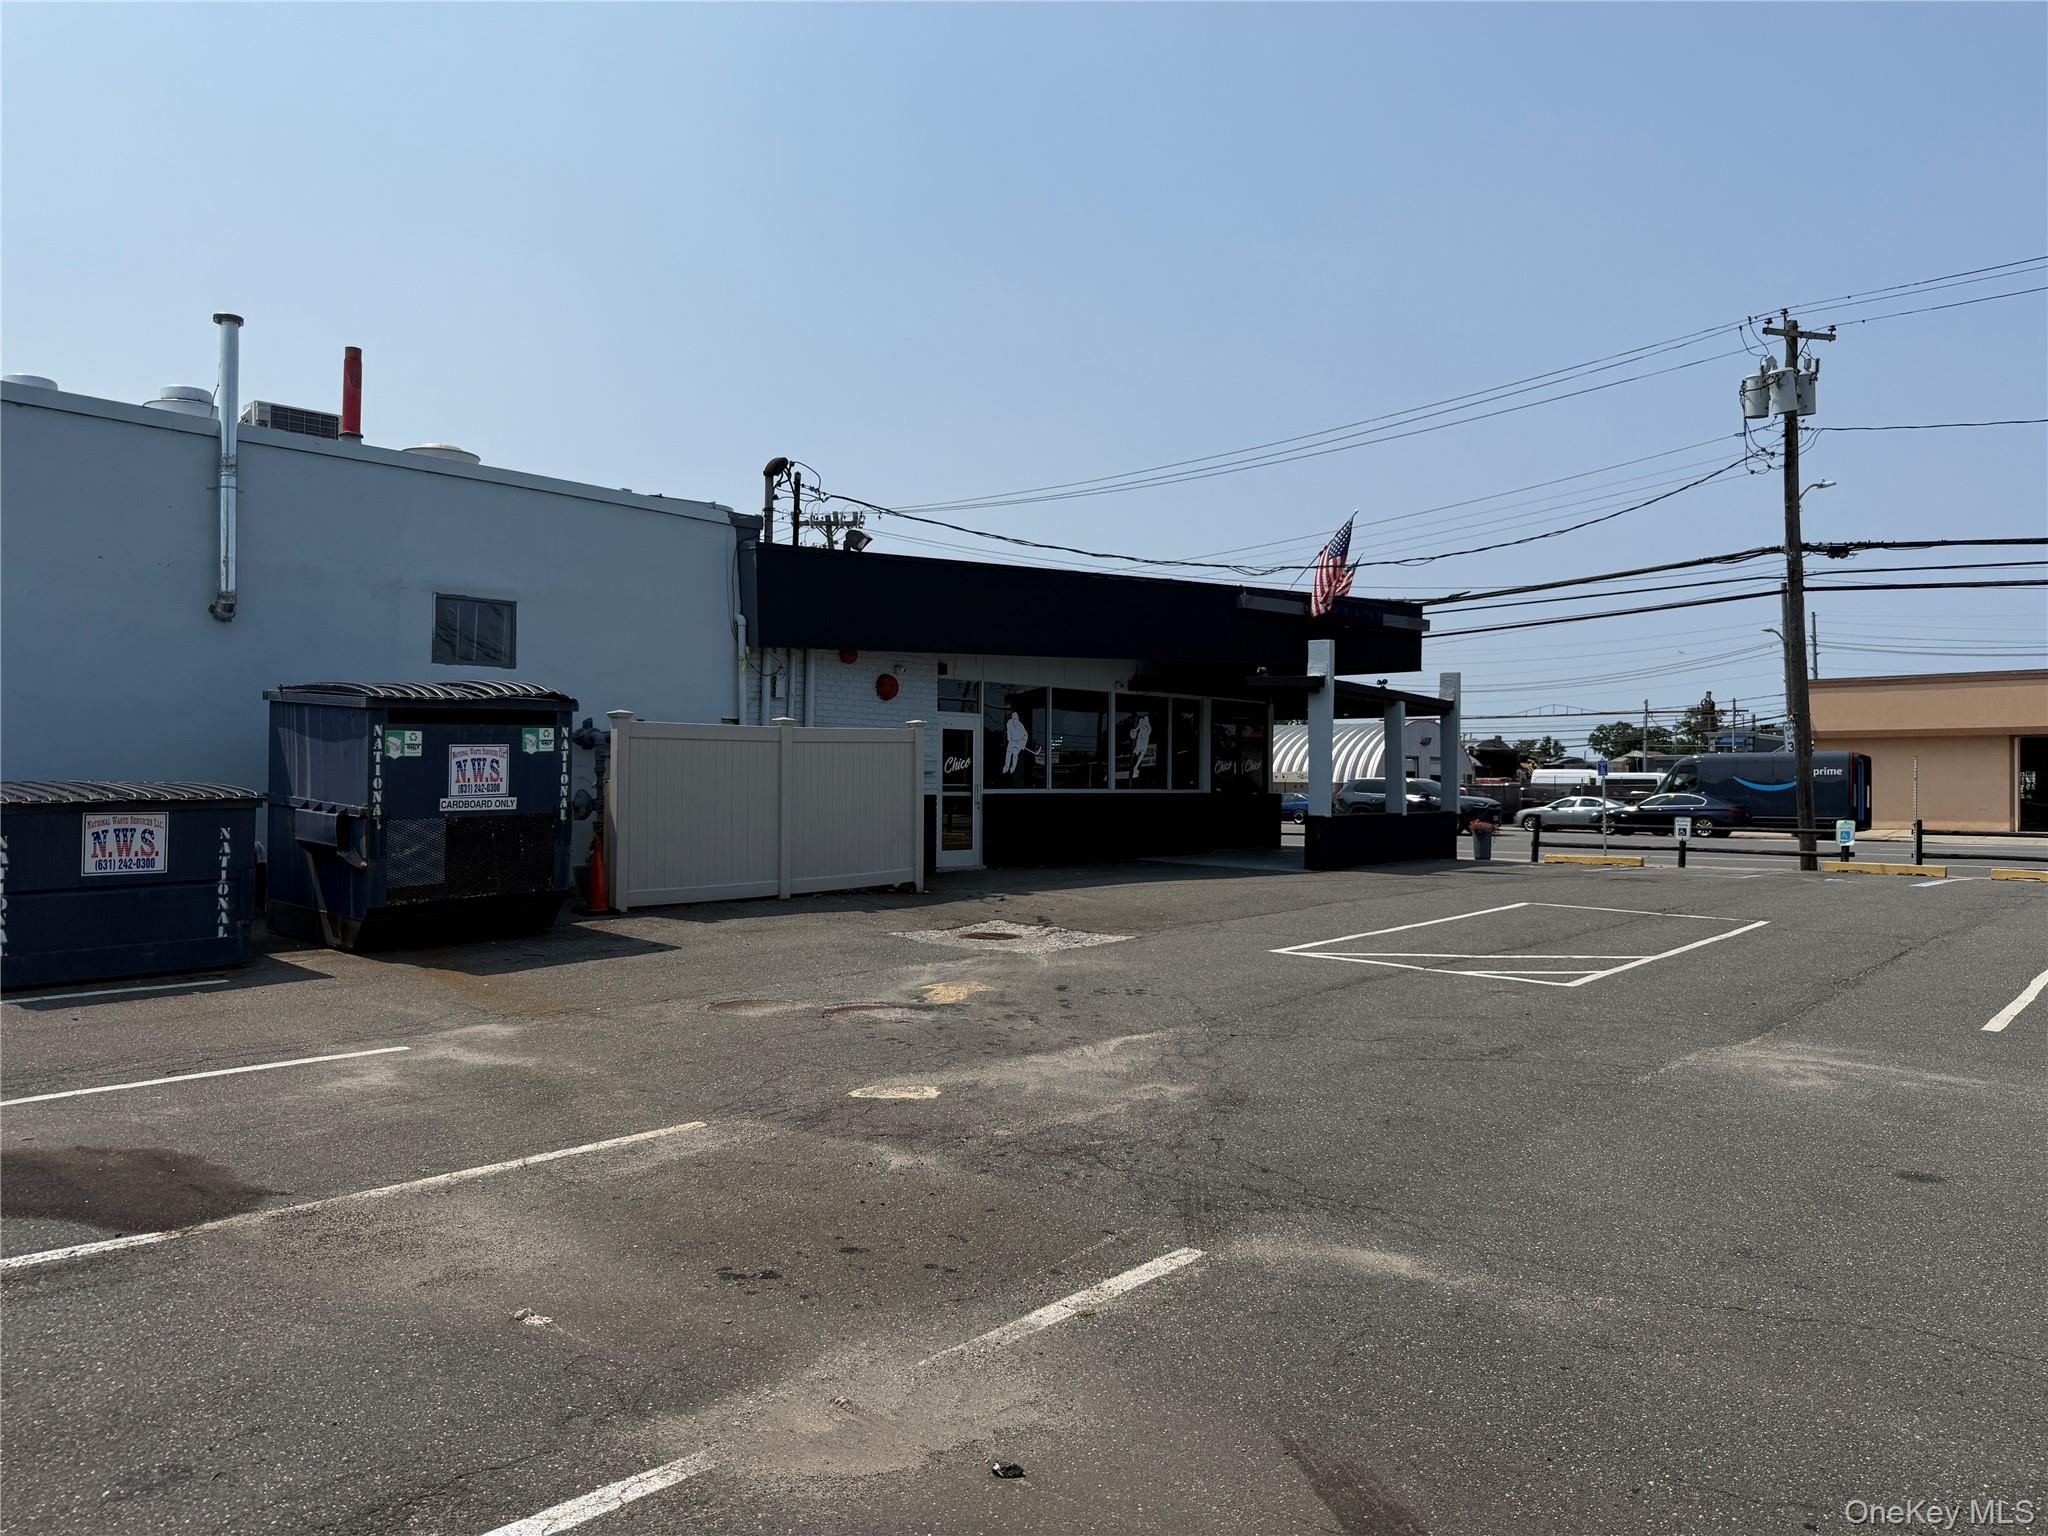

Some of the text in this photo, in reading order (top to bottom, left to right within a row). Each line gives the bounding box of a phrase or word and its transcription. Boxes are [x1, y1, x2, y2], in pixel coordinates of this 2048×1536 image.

[372, 724, 383, 830] NATIONAL
[455, 758, 503, 783] N.W.S.
[560, 727, 569, 820] NATIONAL
[944, 756, 972, 774] Chico
[1813, 766, 1843, 778] prime
[441, 799, 515, 809] CARDBOARD ONLY
[91, 828, 159, 858] N.W.S.
[95, 858, 155, 871] (631) 242-0300
[217, 827, 231, 938] NATIONAL
